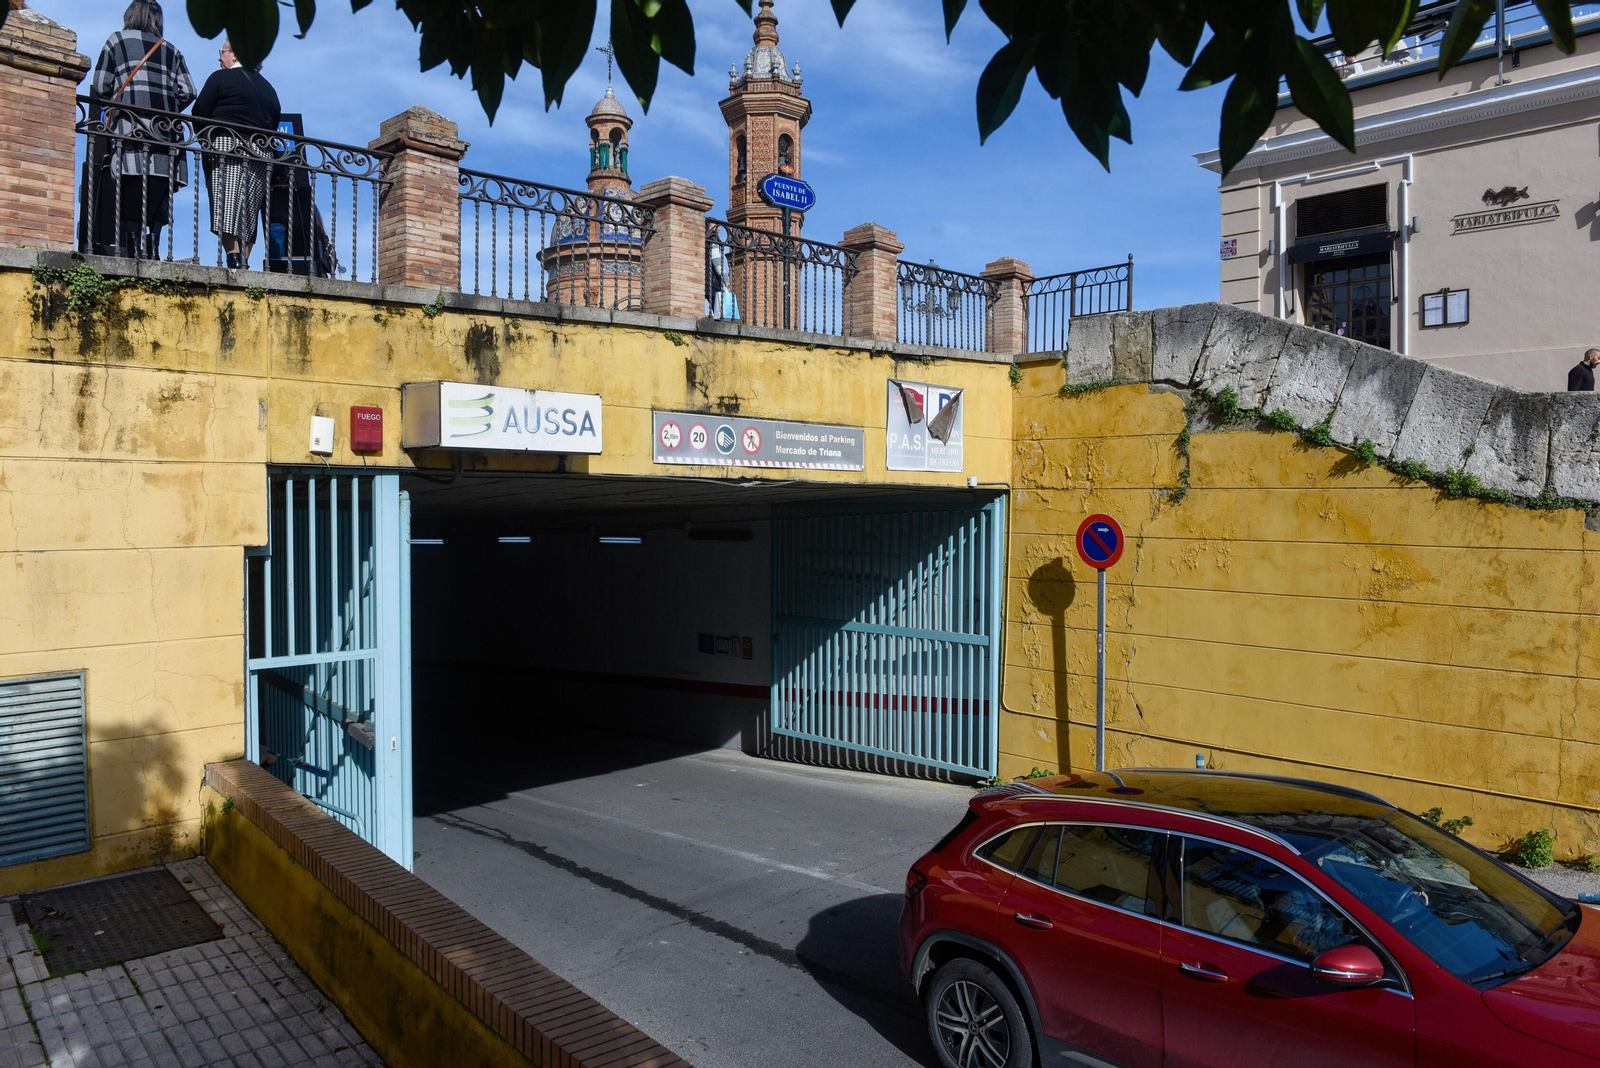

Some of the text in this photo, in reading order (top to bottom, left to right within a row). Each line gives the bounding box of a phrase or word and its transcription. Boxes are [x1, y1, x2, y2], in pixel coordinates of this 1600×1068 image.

[774, 181, 806, 195] PUENTE DE
[772, 188, 807, 204] ISABEL II
[357, 412, 381, 421] FUEGO
[502, 404, 596, 438] AUSSA
[693, 432, 705, 443] 20
[775, 430, 856, 447] Bienvenidos al Parking
[889, 432, 924, 451] P.A.S.
[775, 445, 842, 457] Mercado de Triana
[930, 446, 959, 456] MERCADO
[929, 457, 960, 468] DE TRIANA
